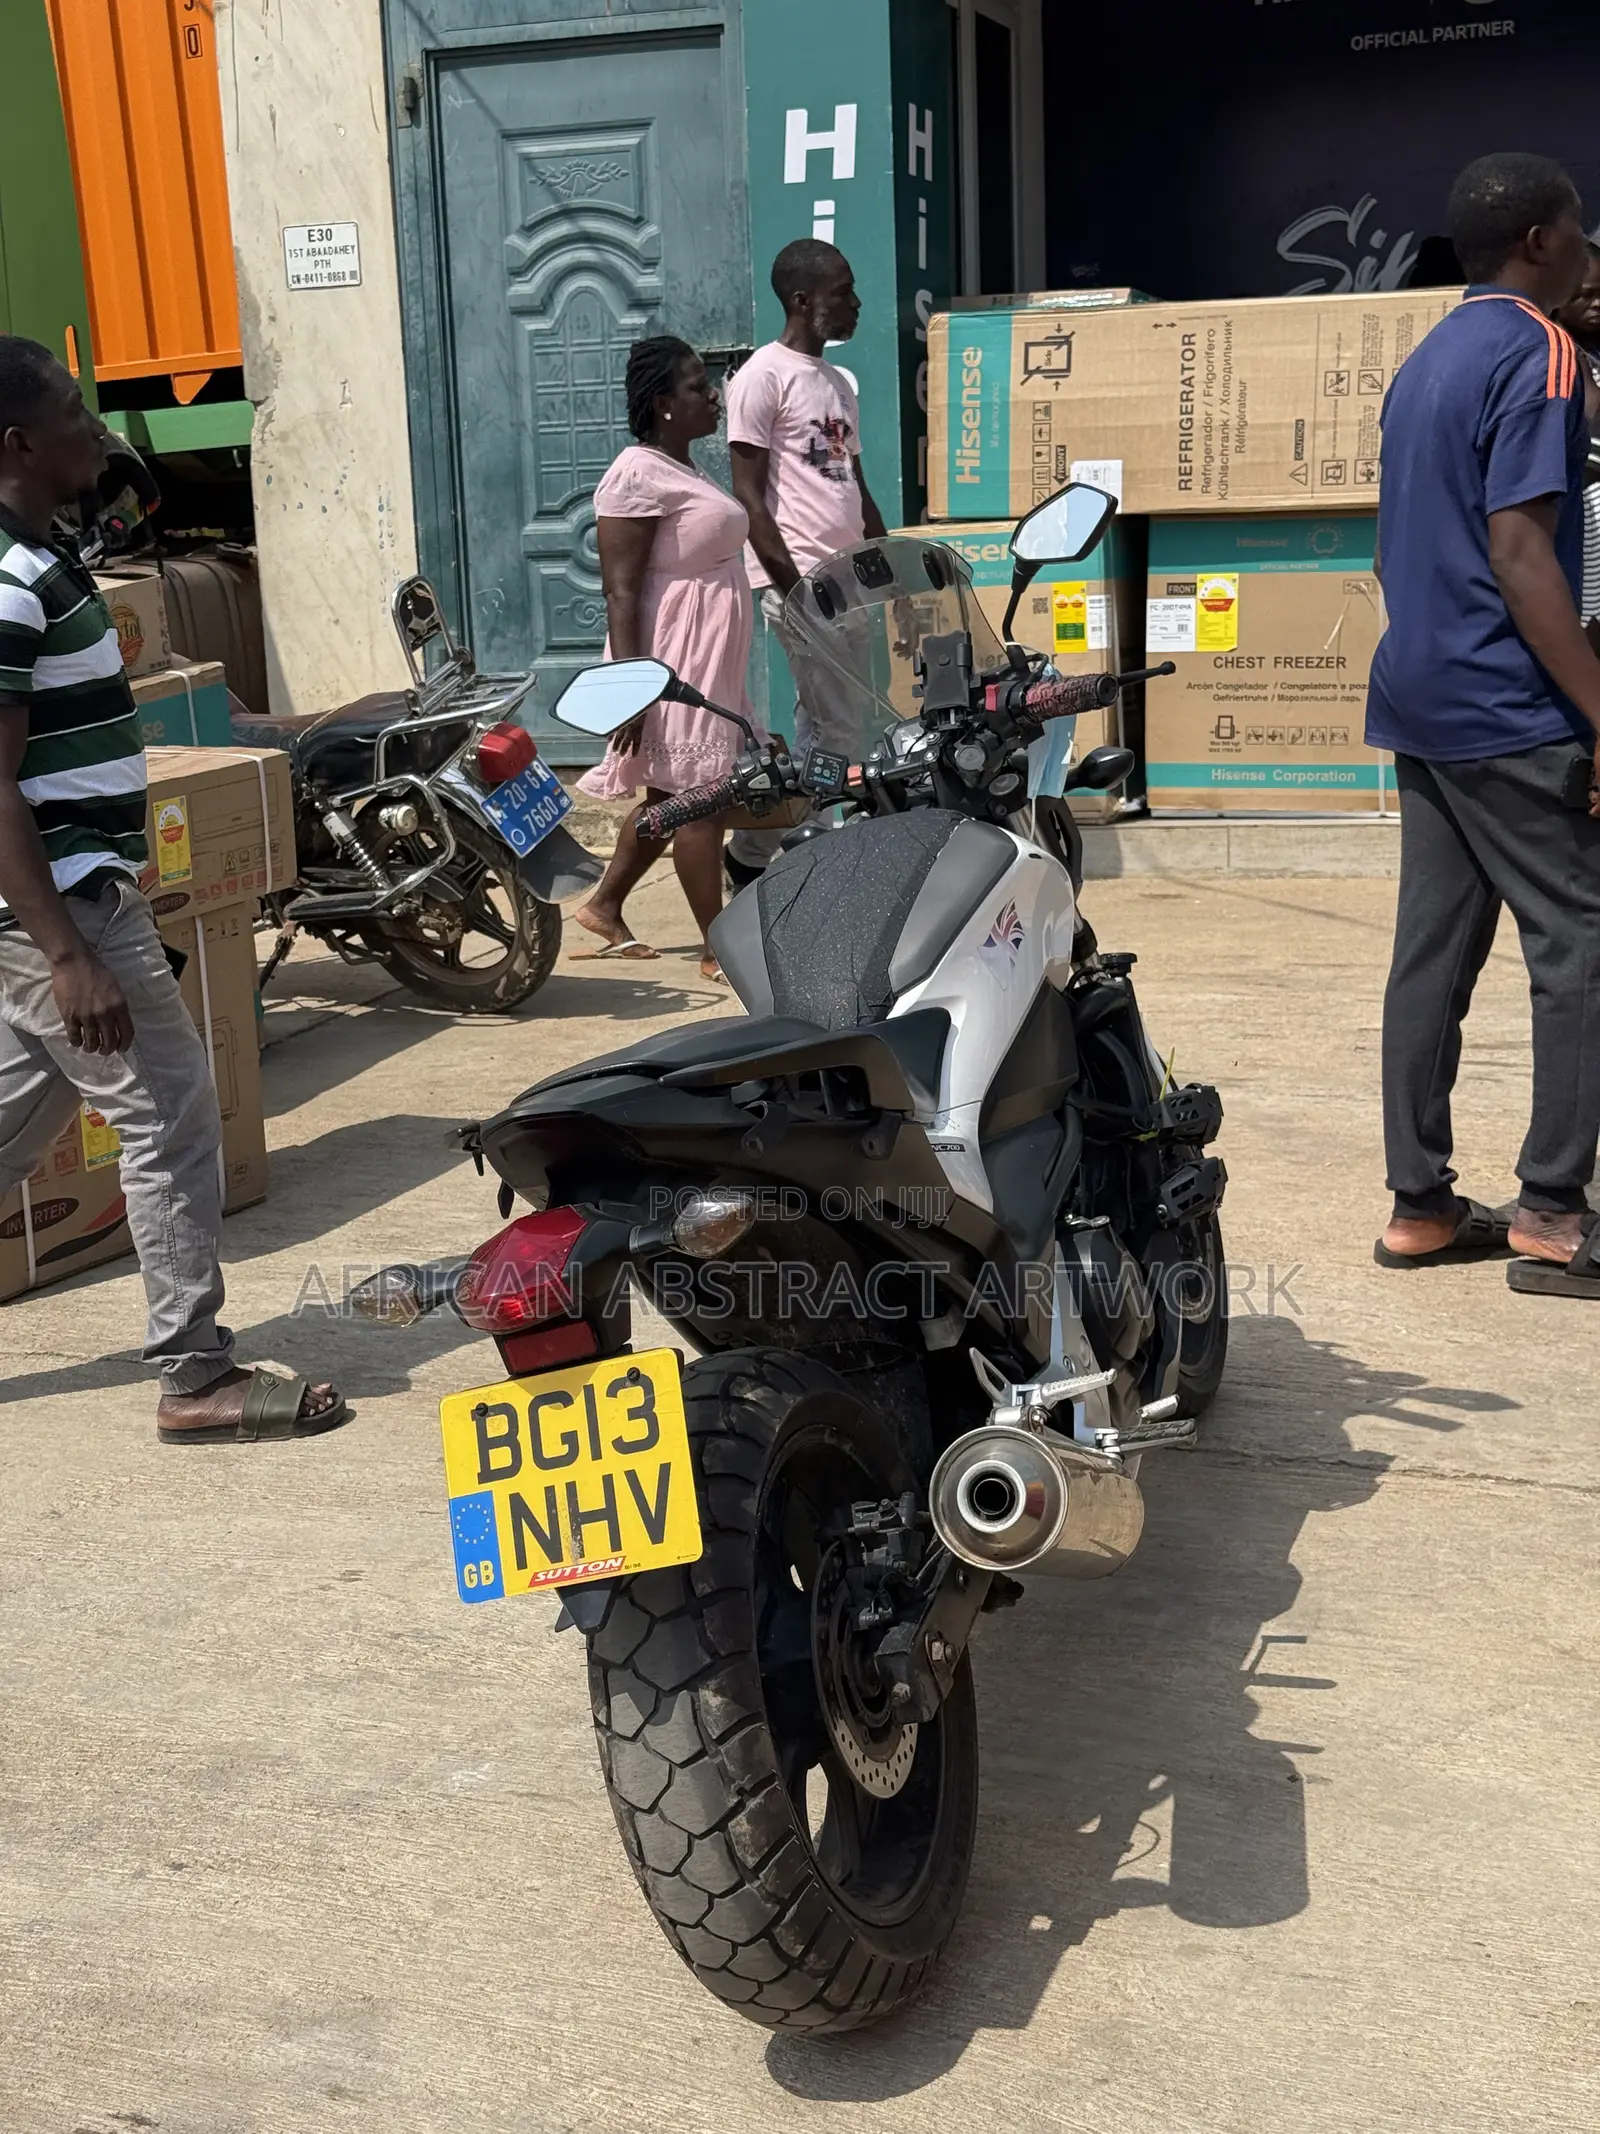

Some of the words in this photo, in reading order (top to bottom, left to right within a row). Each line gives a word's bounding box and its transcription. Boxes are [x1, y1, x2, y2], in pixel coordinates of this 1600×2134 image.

[1351, 29, 1428, 51] OFFICIAL
[1432, 20, 1515, 43] PARTNER
[307, 228, 333, 243] E30
[288, 248, 304, 259] 1ST
[313, 259, 332, 269] PTH
[1220, 320, 1234, 405] Холодильник
[955, 346, 983, 484] Hisense
[1178, 332, 1197, 491] REFRIGERATOR
[1235, 380, 1248, 454] Réfrigérateur
[1201, 411, 1215, 494] Refrigerador
[1295, 421, 1304, 459] CAUTION
[1056, 447, 1065, 480] FRONT
[1218, 419, 1231, 501] Kühlschrank
[1168, 584, 1196, 594] FRONT
[1213, 656, 1266, 669] CHEST
[1273, 656, 1347, 669] FREEZER
[1212, 693, 1268, 702] Gefriertruhe
[1215, 682, 1269, 692] Congelador
[1279, 682, 1337, 692] Congelatore
[1211, 768, 1266, 781] Hisense
[1272, 768, 1357, 783] Corporation
[521, 795, 559, 837] 7660
[471, 1372, 661, 1485] BG13
[508, 1461, 672, 1571] NHV
[463, 1560, 495, 1589] GB
[534, 1556, 625, 1582] SUTTON
